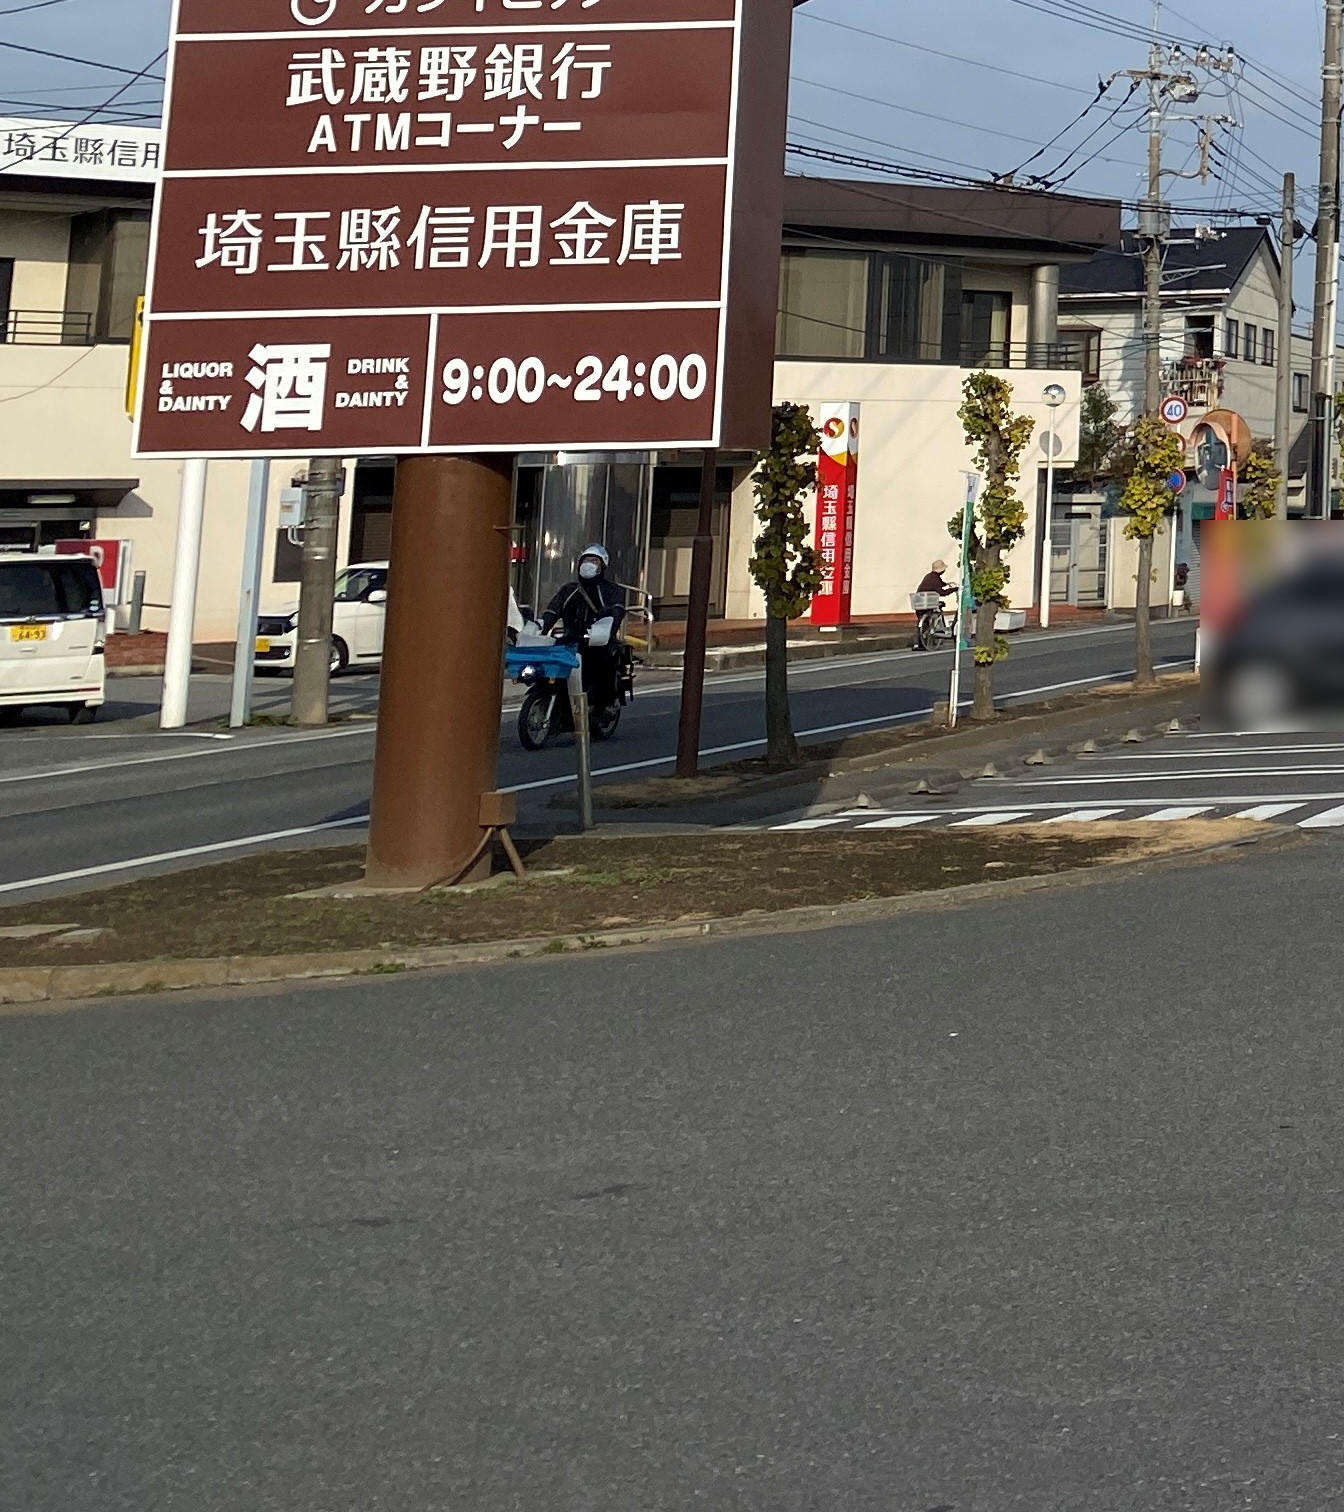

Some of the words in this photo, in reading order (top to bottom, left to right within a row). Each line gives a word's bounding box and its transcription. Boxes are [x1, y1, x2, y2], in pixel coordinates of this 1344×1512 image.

[285, 42, 612, 107] 武蔵野銀行
[306, 106, 582, 154] ATMコーナー
[194, 198, 686, 276] 埼玉縣信用金庫
[161, 360, 234, 380] LIQUOR
[347, 356, 410, 375] DRINK
[158, 379, 174, 395] &
[239, 342, 331, 434] 酒
[394, 374, 409, 391] &
[157, 394, 231, 413] DAINTY
[334, 390, 409, 409] DAINTY
[1166, 404, 1182, 417] 40
